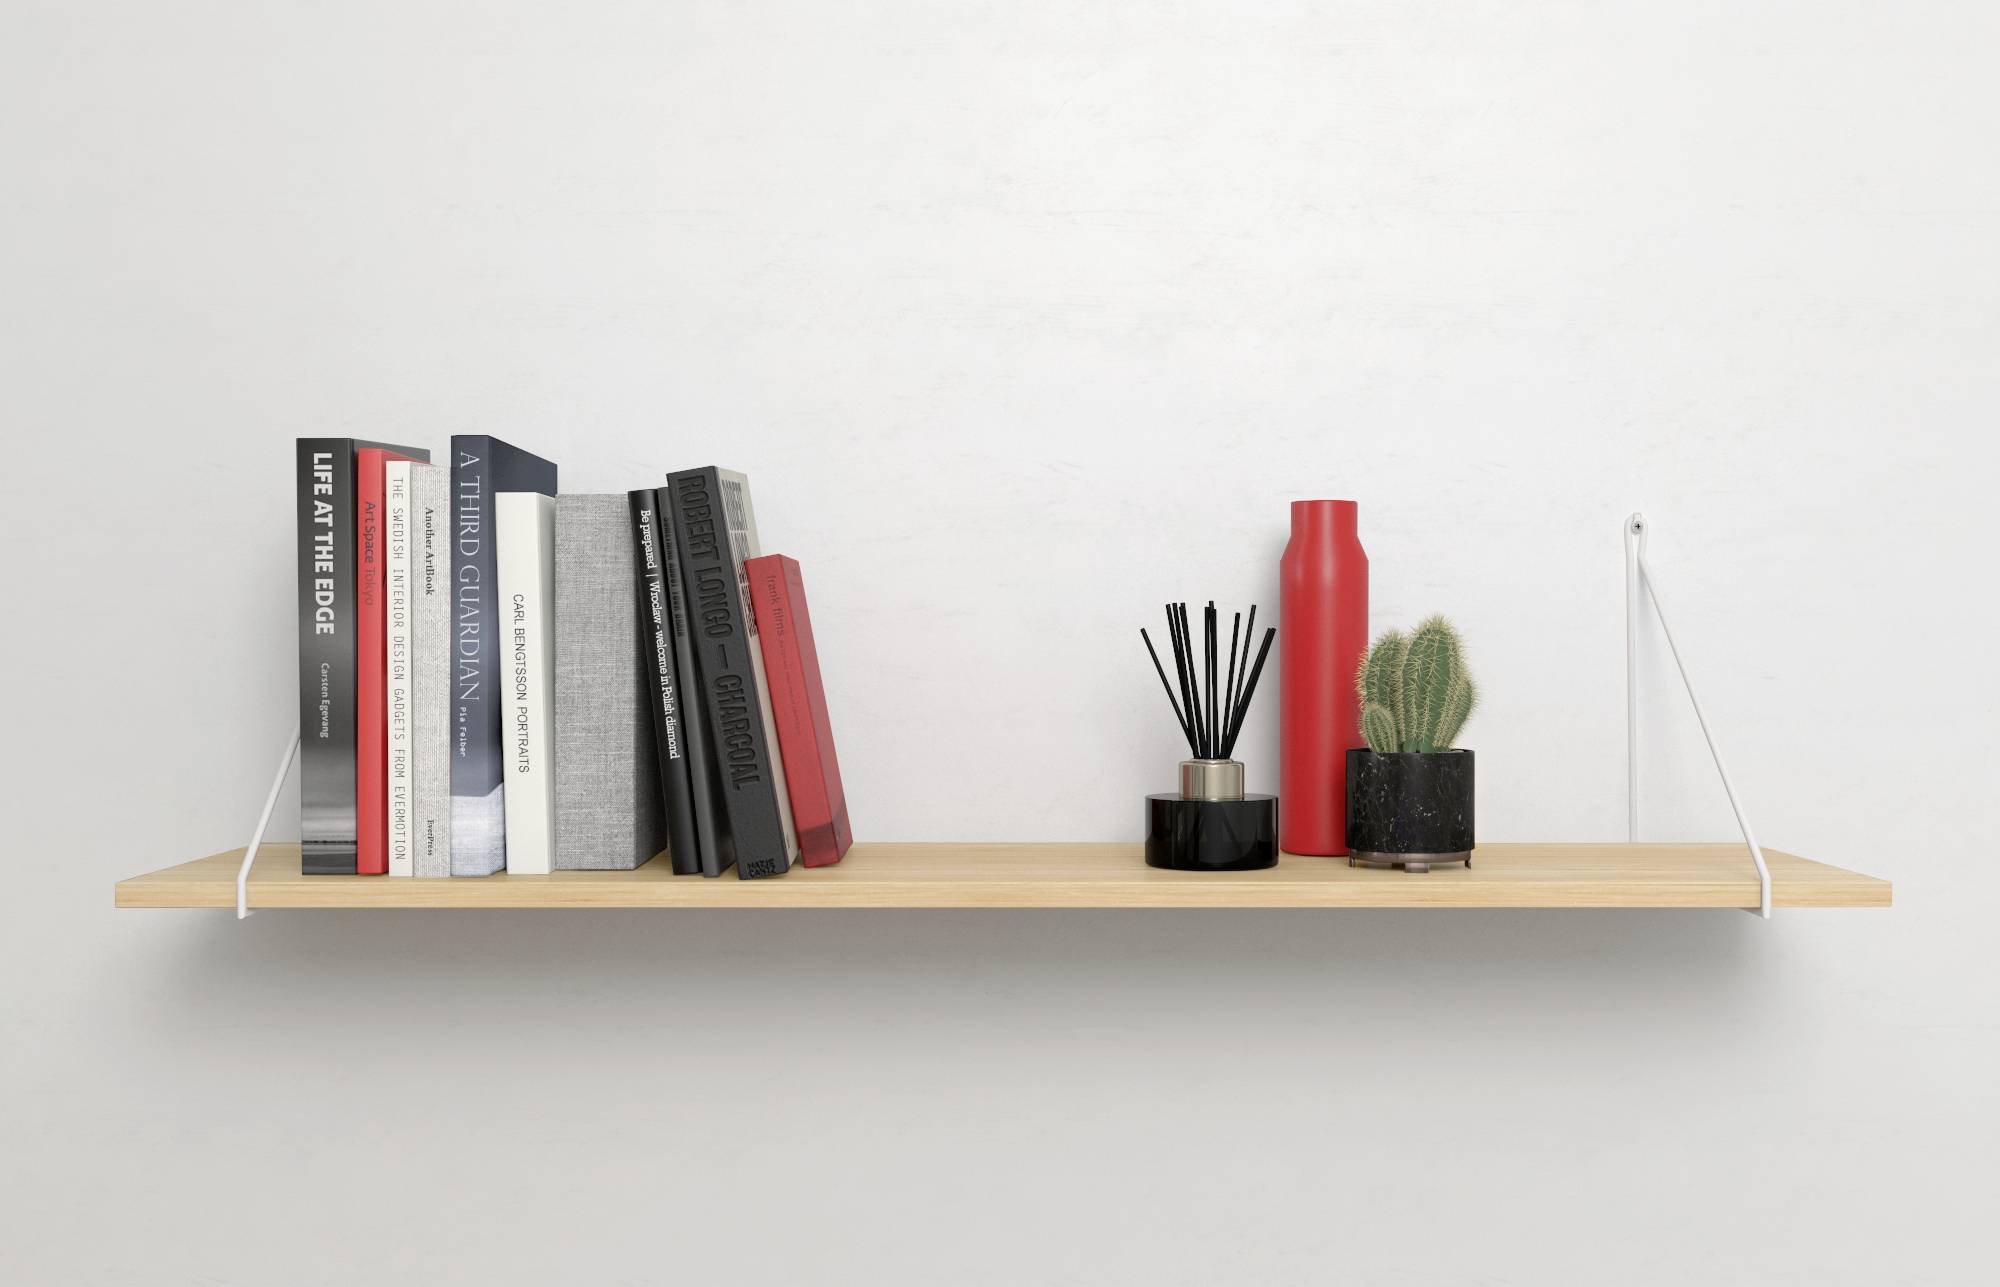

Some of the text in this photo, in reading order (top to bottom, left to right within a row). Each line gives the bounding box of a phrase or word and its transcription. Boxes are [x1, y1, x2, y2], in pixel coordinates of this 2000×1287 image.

[313, 452, 335, 635] LIFE AT THE EDGE
[363, 501, 376, 606] Art Space Tokyo
[425, 507, 435, 596] Another ArtBook
[639, 523, 658, 570] prepared
[640, 509, 651, 523] Be
[677, 474, 721, 561] ROBERT
[459, 451, 480, 701] A THIRD GUARDIAN
[649, 580, 663, 624] Wroclaw
[695, 566, 734, 640] LONGO
[392, 477, 406, 860] THE SWEDISH INTERIOR DESIGN GADGETS FROM EVERMOTION
[513, 593, 530, 773] CARL BENGTSSON PORTRAITS
[655, 629, 667, 675] welcome
[660, 675, 671, 685] in
[319, 662, 330, 738] Carsten Egevang
[661, 685, 675, 715] Polish
[665, 715, 681, 760] diamond
[713, 674, 760, 791] CHARCOAL
